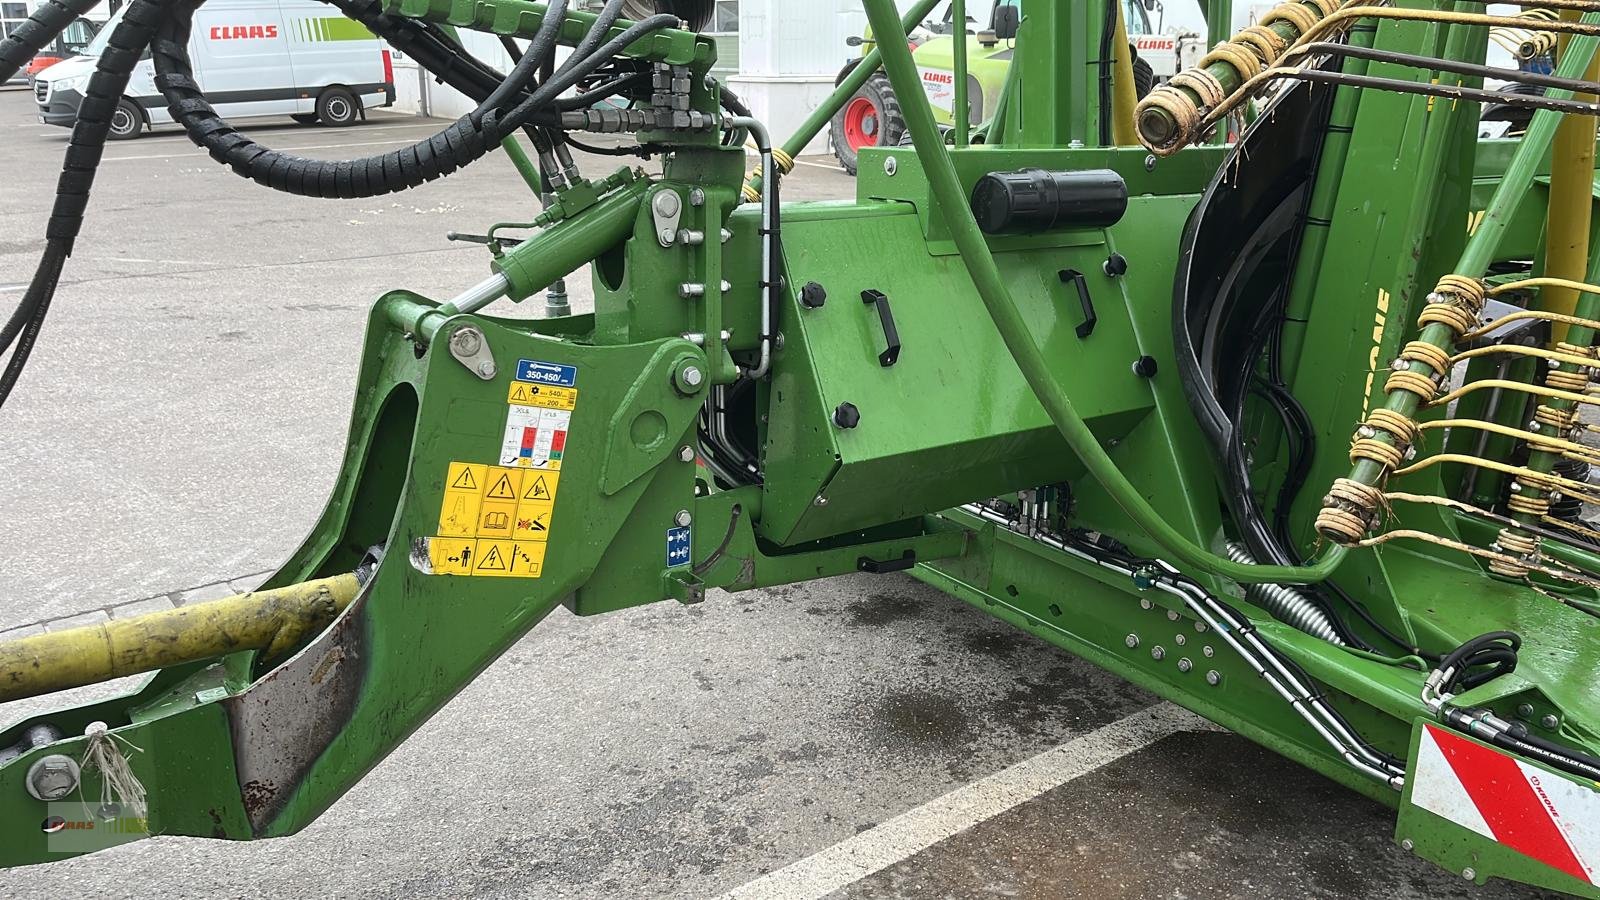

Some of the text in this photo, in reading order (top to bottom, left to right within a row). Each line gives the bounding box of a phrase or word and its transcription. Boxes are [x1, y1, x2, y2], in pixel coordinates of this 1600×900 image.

[210, 26, 277, 39] CLAAS
[1137, 40, 1173, 50] CLAAS
[923, 72, 952, 84] CLAAS
[1516, 741, 1551, 756] HYDRAULIK
[1550, 752, 1578, 766] MUELLER
[1535, 785, 1560, 818] KRONE
